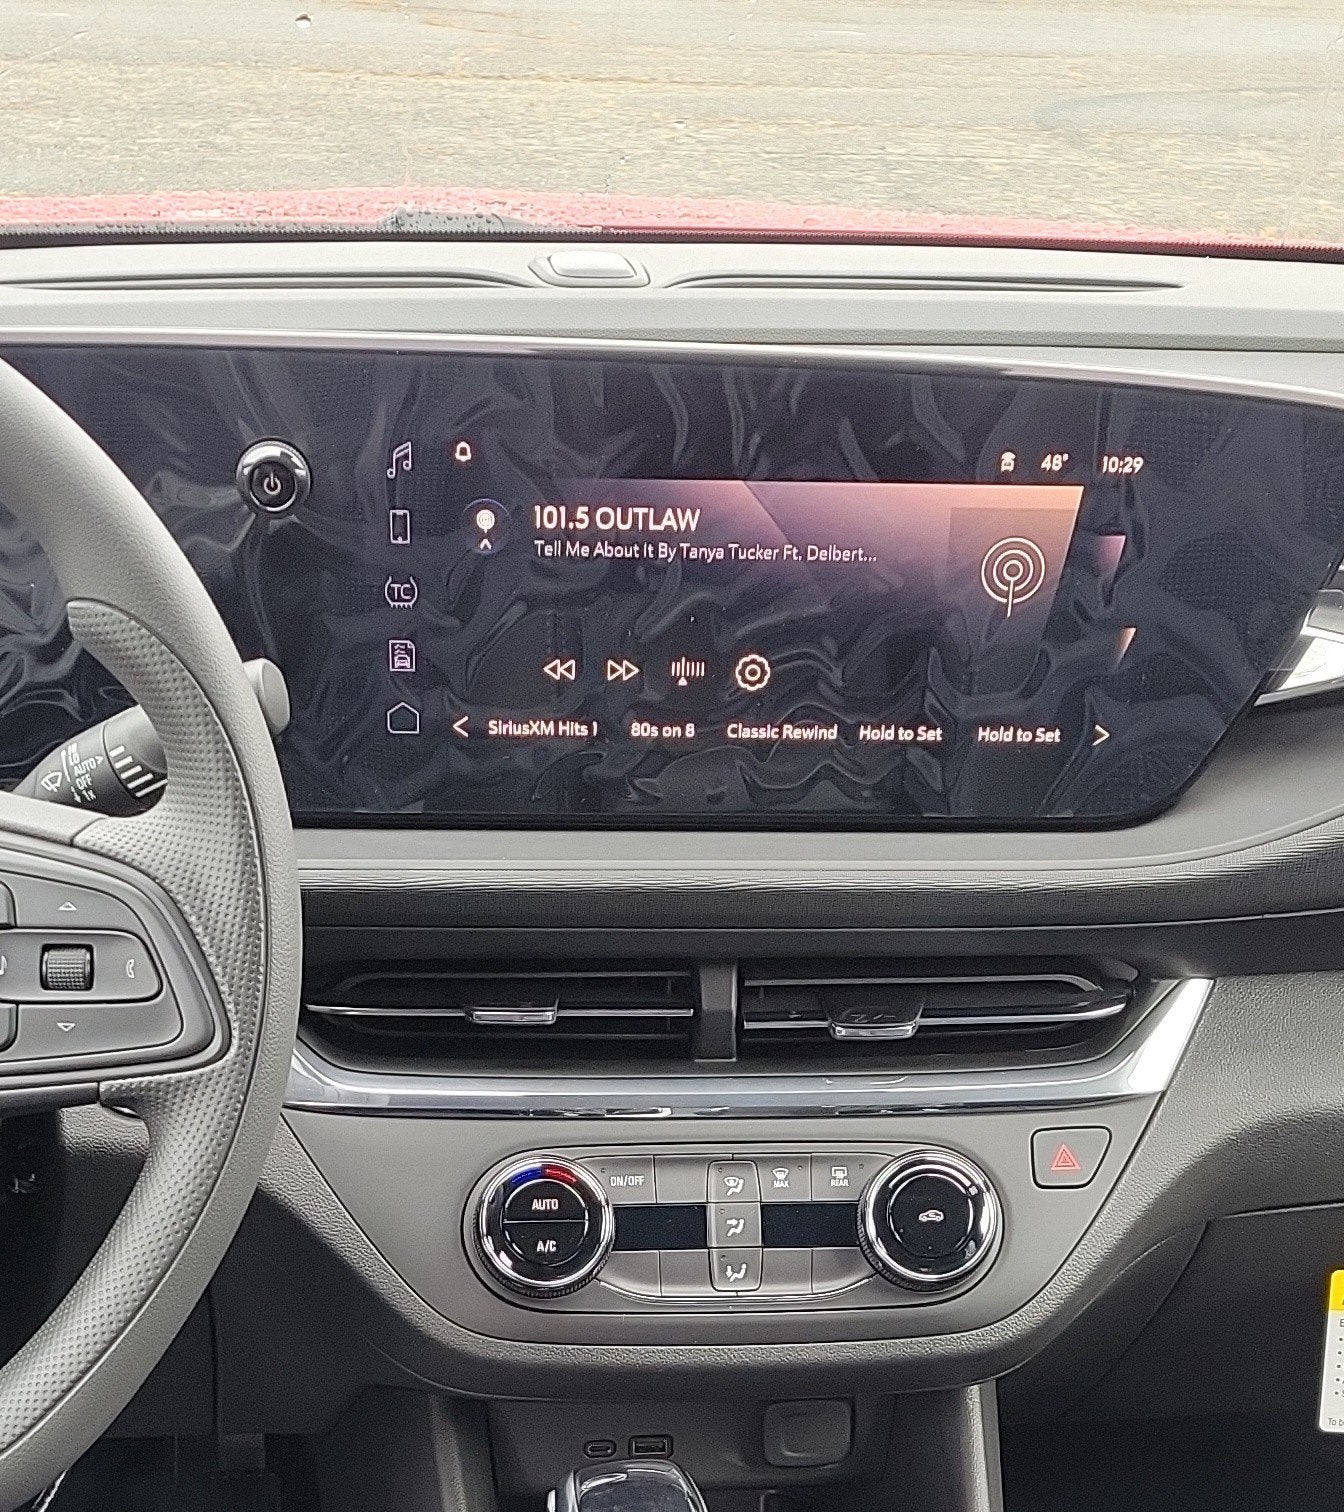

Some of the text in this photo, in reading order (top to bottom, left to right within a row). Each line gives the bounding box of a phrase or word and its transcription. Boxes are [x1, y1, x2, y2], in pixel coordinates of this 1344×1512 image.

[1102, 455, 1144, 474] 10:29
[533, 505, 702, 532] 101.5 OUTLAW
[534, 540, 562, 558] Tell
[565, 540, 591, 558] Me
[593, 541, 641, 559] About
[643, 541, 655, 559] It
[658, 542, 677, 563] By
[679, 543, 725, 563] Tanya
[728, 543, 780, 562] Tucker
[783, 544, 803, 561] Ft.
[487, 719, 599, 738] SiriusXM Hits 1
[630, 721, 696, 738] 80s on 8
[726, 723, 838, 741] Classic Rewind
[859, 723, 943, 742] Hold to Set
[977, 726, 1061, 743] Hold to Set
[69, 752, 80, 766] LO
[73, 757, 97, 777] AUTO
[75, 774, 93, 790] OFF
[610, 1175, 646, 1188] ON/OFF
[773, 1179, 790, 1188] MAX
[830, 1179, 850, 1187] REAR
[531, 1198, 560, 1210] AUTO
[536, 1240, 557, 1252] A/C
[1328, 1417, 1337, 1426] To
